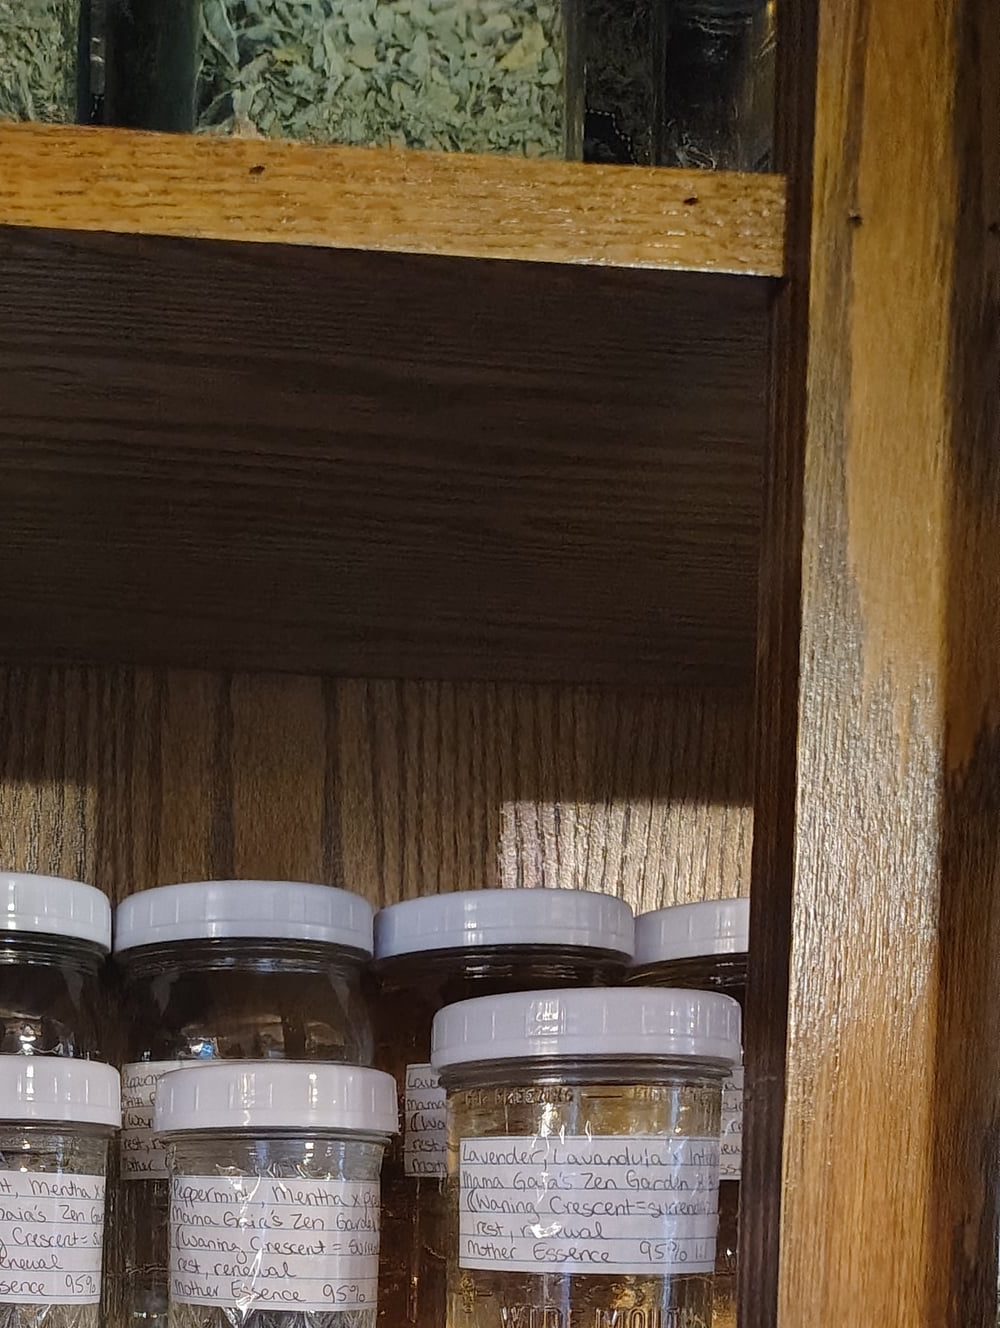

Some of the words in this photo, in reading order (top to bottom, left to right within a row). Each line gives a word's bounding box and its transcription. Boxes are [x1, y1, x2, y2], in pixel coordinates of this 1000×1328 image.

[462, 1143, 547, 1171] Lavender,
[29, 1178, 91, 1199] Mentha
[463, 1171, 505, 1190] Mama
[580, 1172, 619, 1190] Zen
[272, 1185, 349, 1206] Mentha
[58, 1204, 85, 1222] Zen
[172, 1207, 220, 1226] Mama
[290, 1213, 325, 1231] Zen
[476, 1220, 514, 1243] rest,
[467, 1239, 517, 1260] Mother
[532, 1241, 616, 1263] Essence
[639, 1240, 688, 1262] 95%
[177, 1257, 209, 1280] rest,
[65, 1274, 96, 1295] 95%
[174, 1280, 220, 1297] Mother
[322, 1284, 366, 1304] 95%
